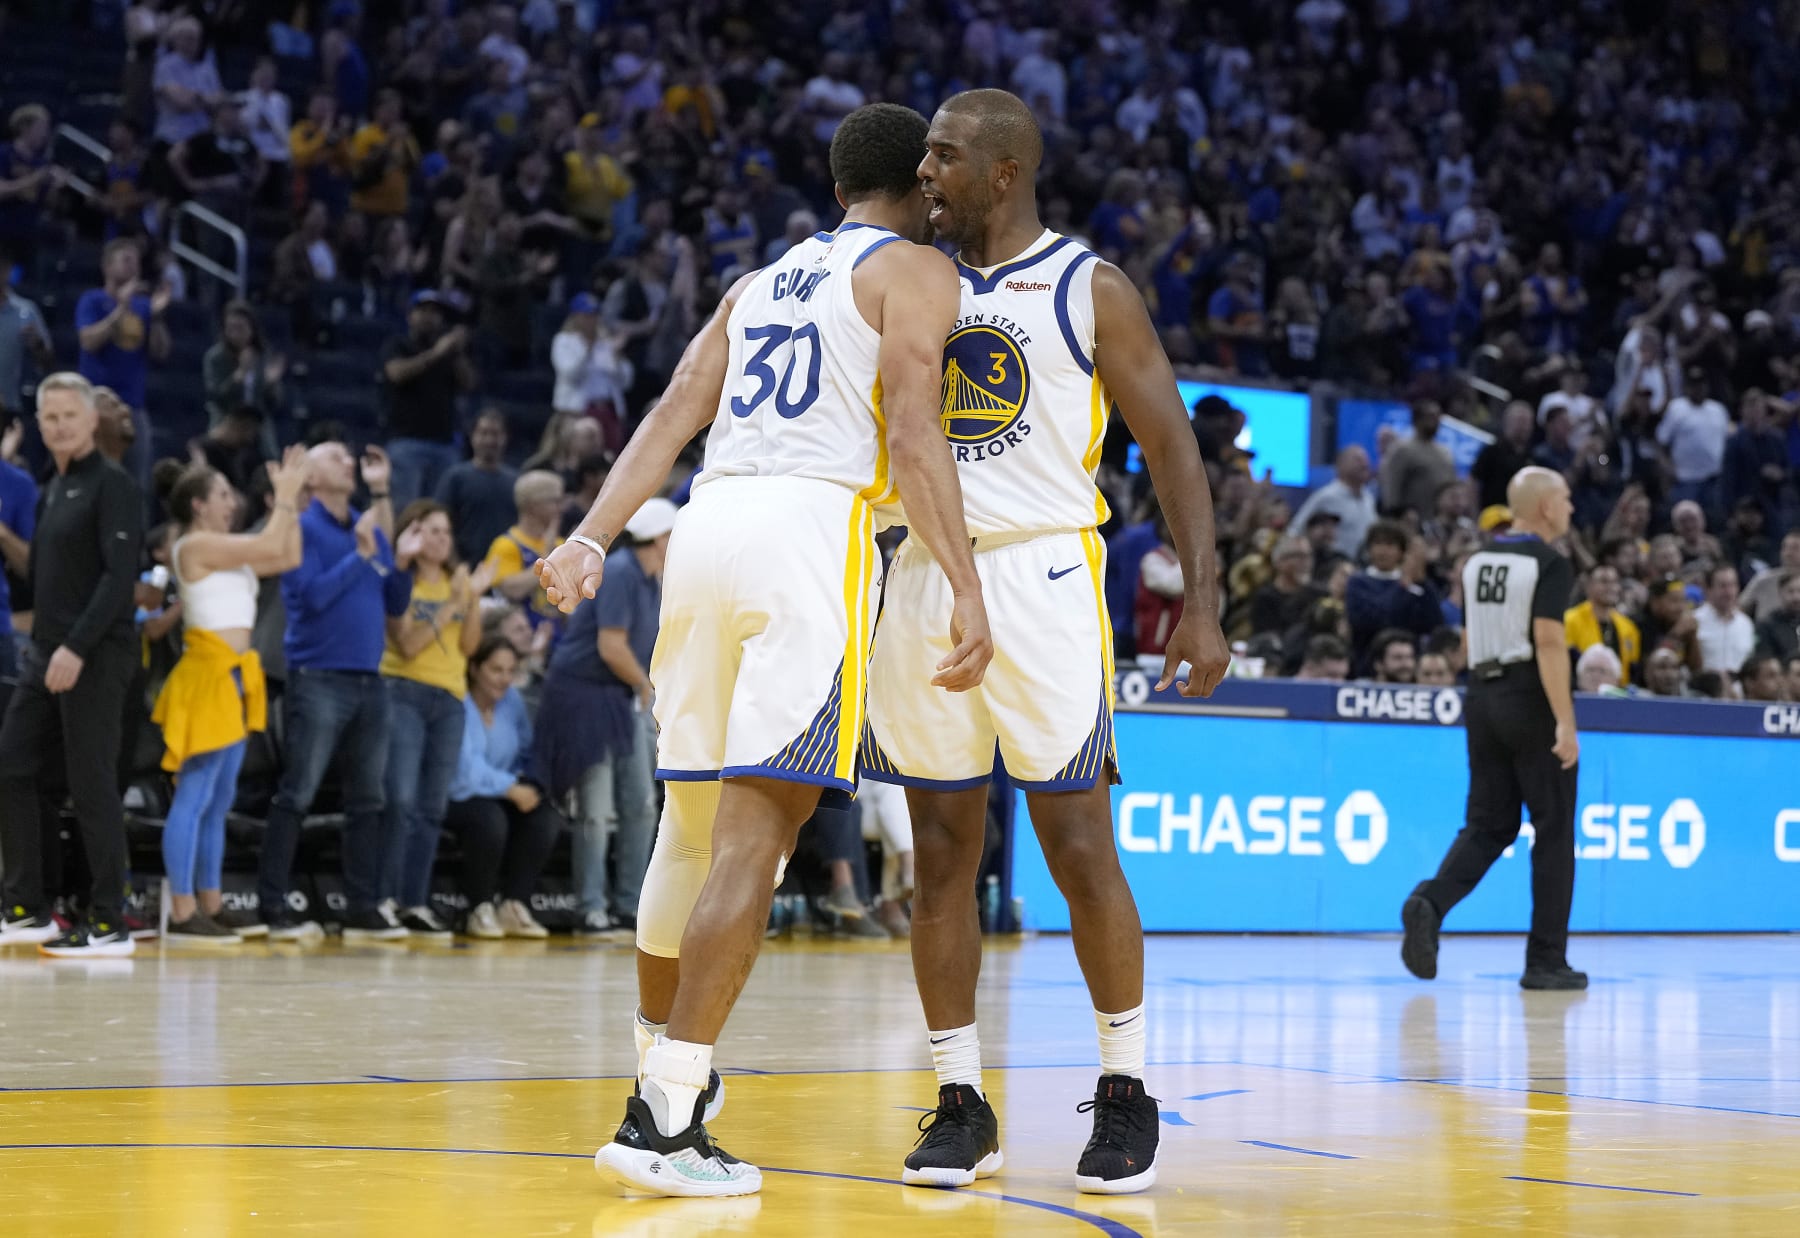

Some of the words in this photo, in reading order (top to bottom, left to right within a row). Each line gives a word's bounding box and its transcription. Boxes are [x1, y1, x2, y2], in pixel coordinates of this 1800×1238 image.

[773, 267, 831, 303] CURY
[1005, 281, 1051, 292] Rakuten
[953, 313, 985, 331] DEN
[990, 314, 1032, 347] STATE
[731, 322, 822, 419] 30
[986, 352, 1008, 385] 3
[950, 419, 1032, 463] RIORS
[1477, 565, 1508, 605] 68
[1336, 687, 1432, 720] CHASE
[1118, 792, 1326, 856] CHASE
